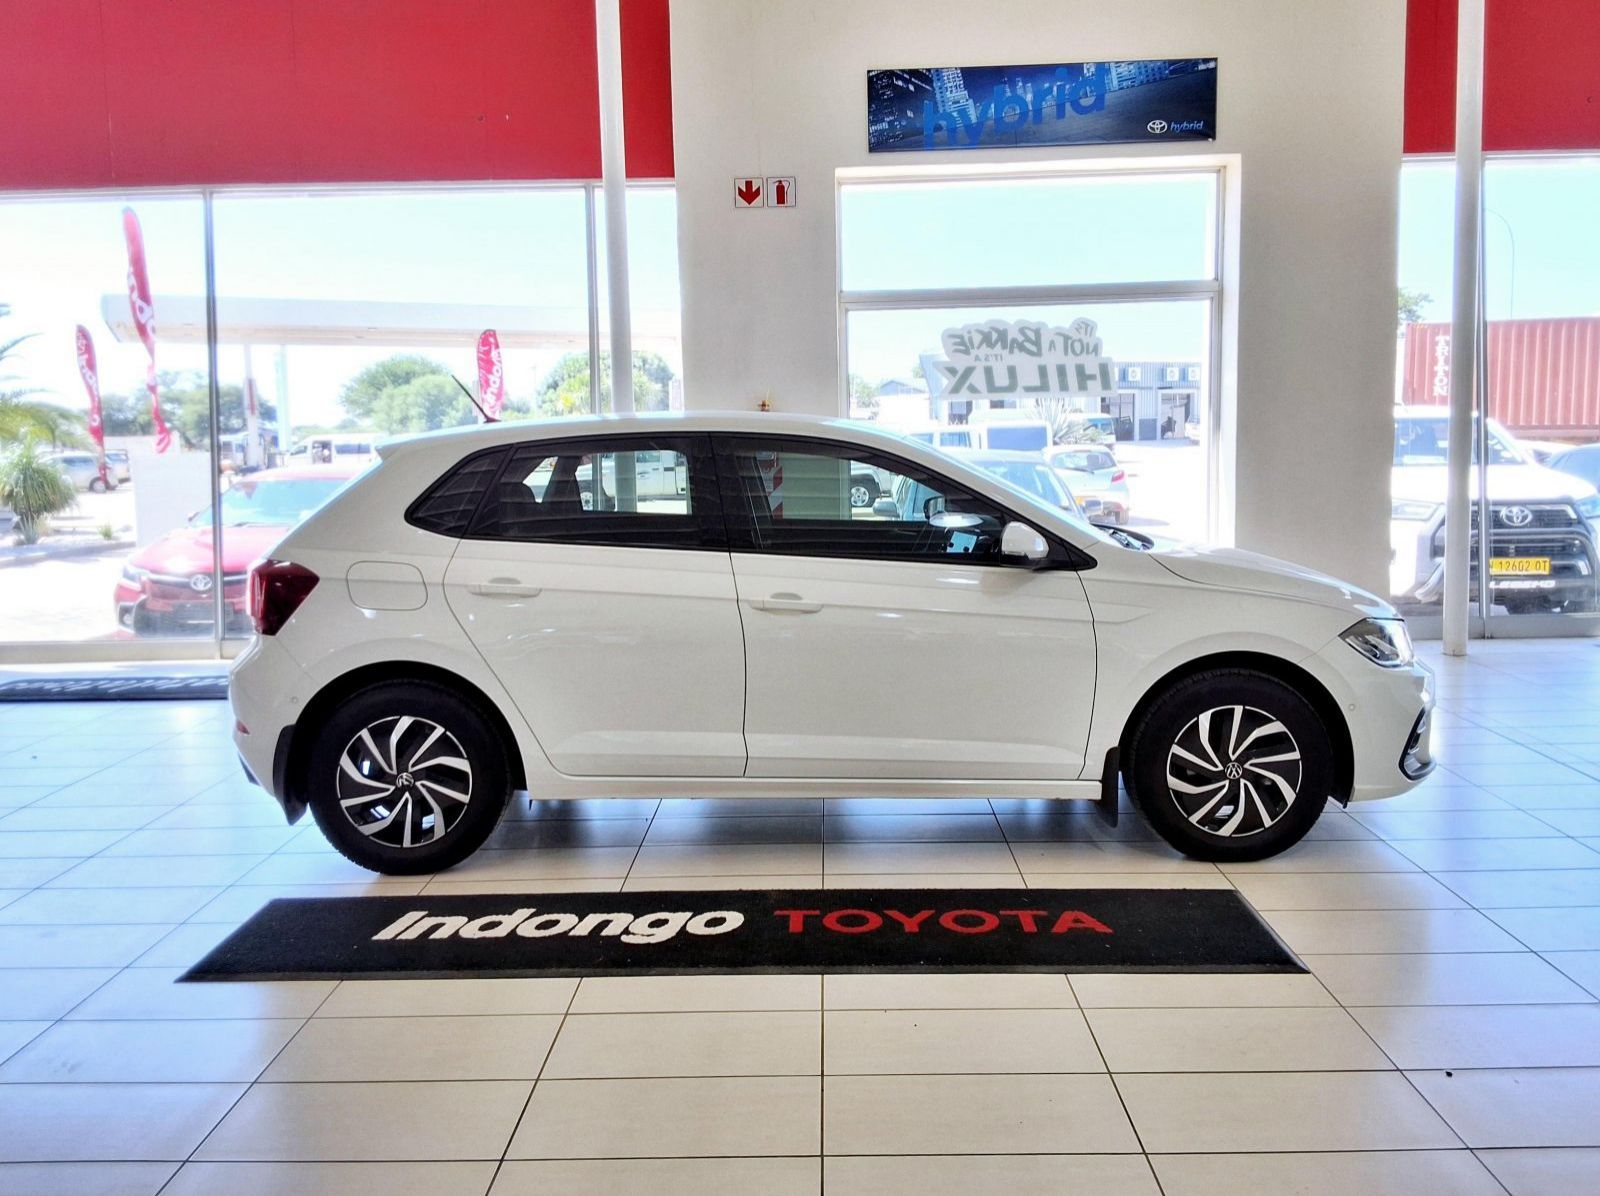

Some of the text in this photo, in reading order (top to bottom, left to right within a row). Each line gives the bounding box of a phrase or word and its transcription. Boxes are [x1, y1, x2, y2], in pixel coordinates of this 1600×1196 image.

[922, 65, 1107, 150] hybrid
[1170, 120, 1204, 133] hybrid
[1433, 335, 1450, 396] TRITON
[1499, 560, 1531, 572] 12602
[371, 908, 1114, 944] Indongo TOYOTA
